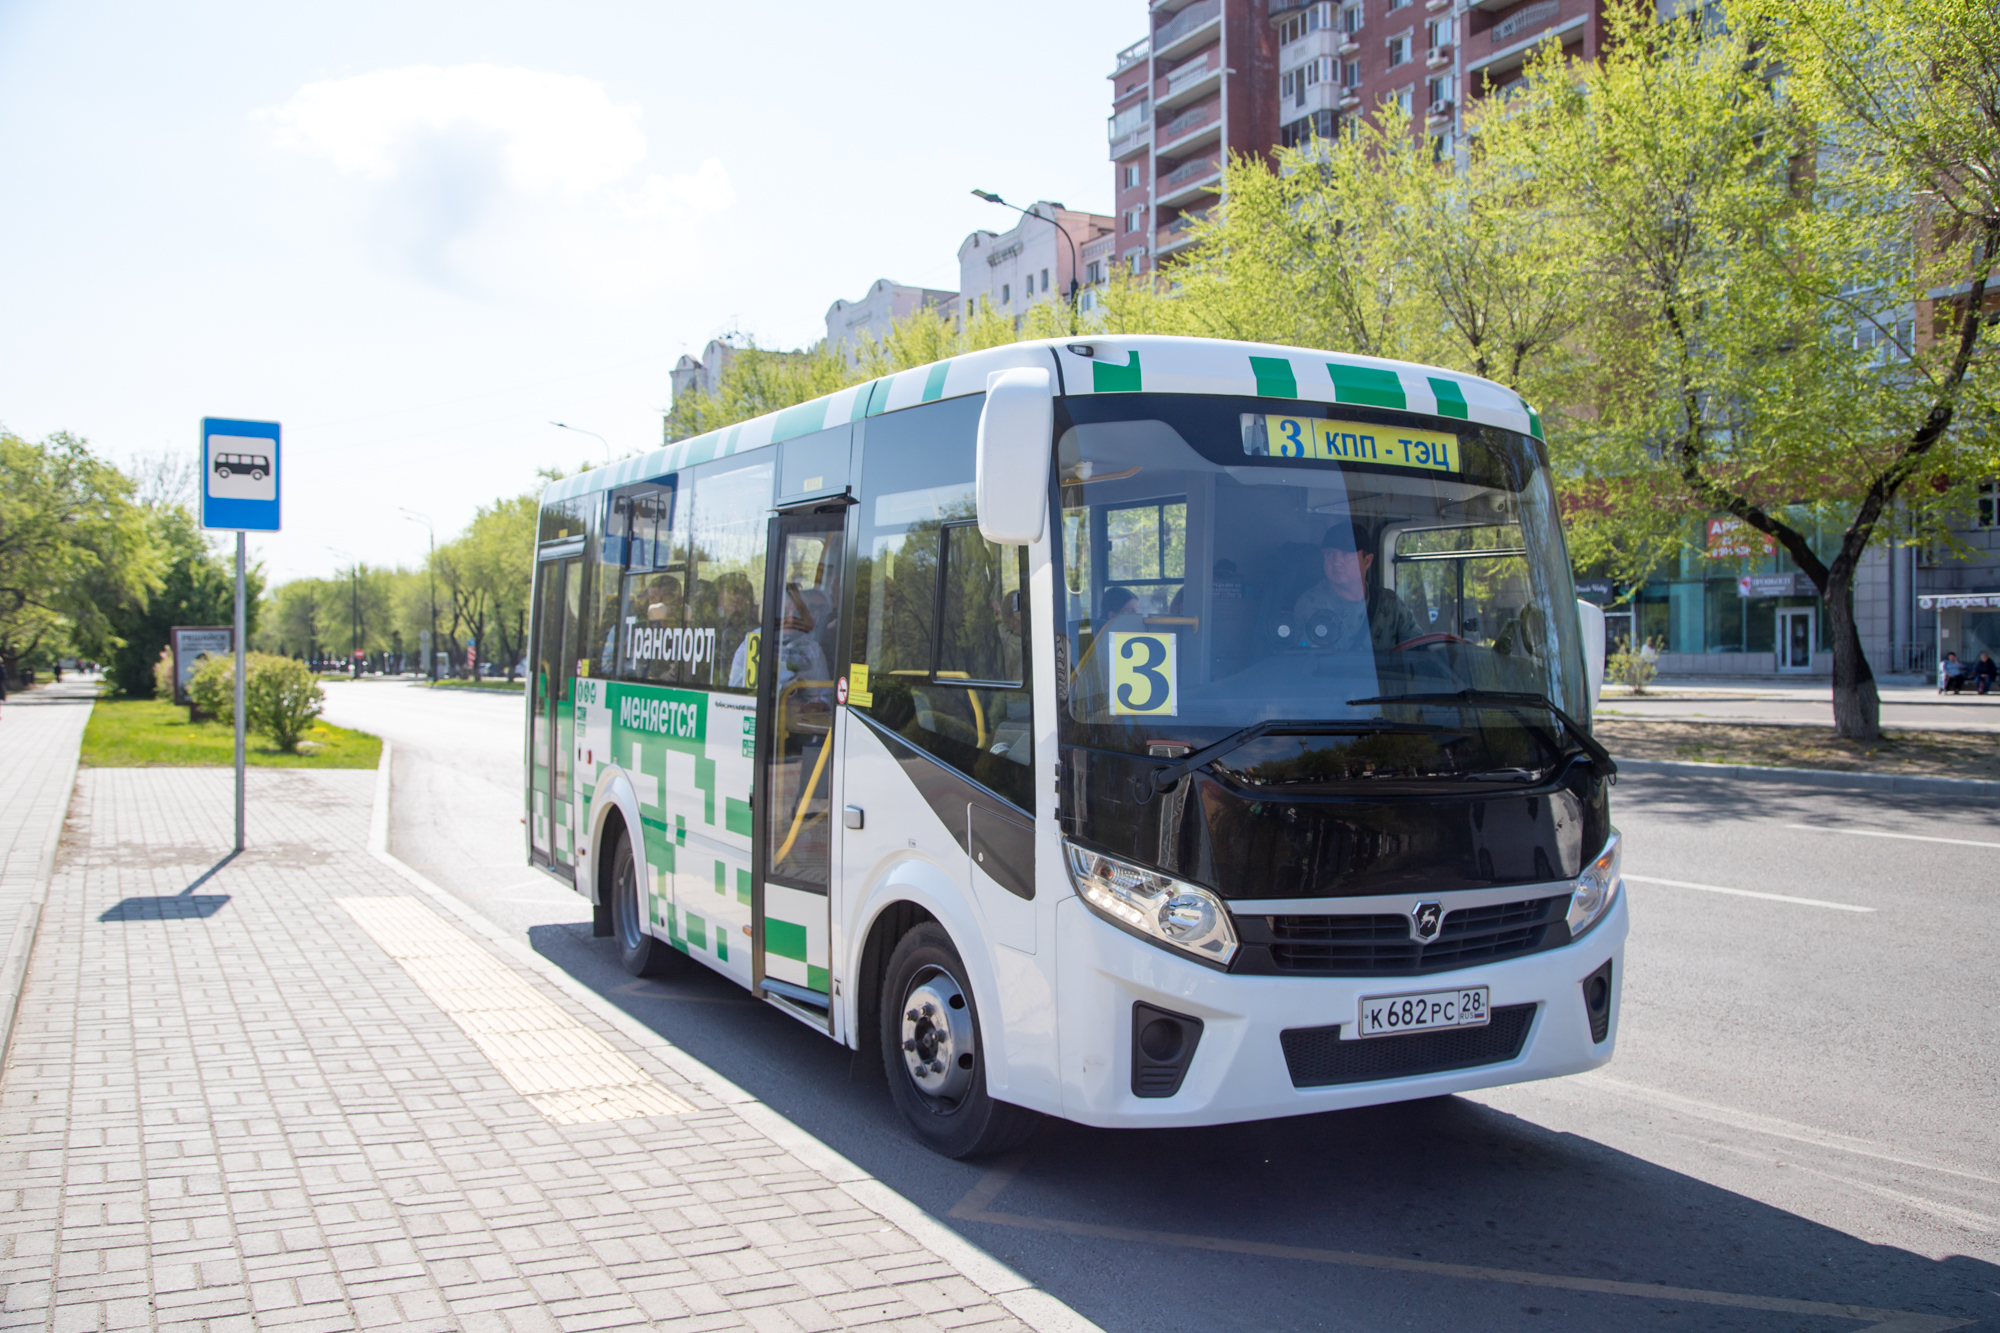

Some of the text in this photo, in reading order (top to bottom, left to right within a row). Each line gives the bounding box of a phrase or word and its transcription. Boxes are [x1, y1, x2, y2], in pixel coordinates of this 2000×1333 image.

[1280, 419, 1305, 458] 3
[1325, 431, 1377, 459] КПП
[1398, 438, 1450, 472] ТЭЦ
[625, 616, 715, 675] Транспорт
[747, 635, 761, 688] 3
[1116, 636, 1170, 711] 3
[620, 695, 698, 739] меняется
[1371, 991, 1481, 1029] К682РС 28
[1460, 1012, 1474, 1020] RUS
